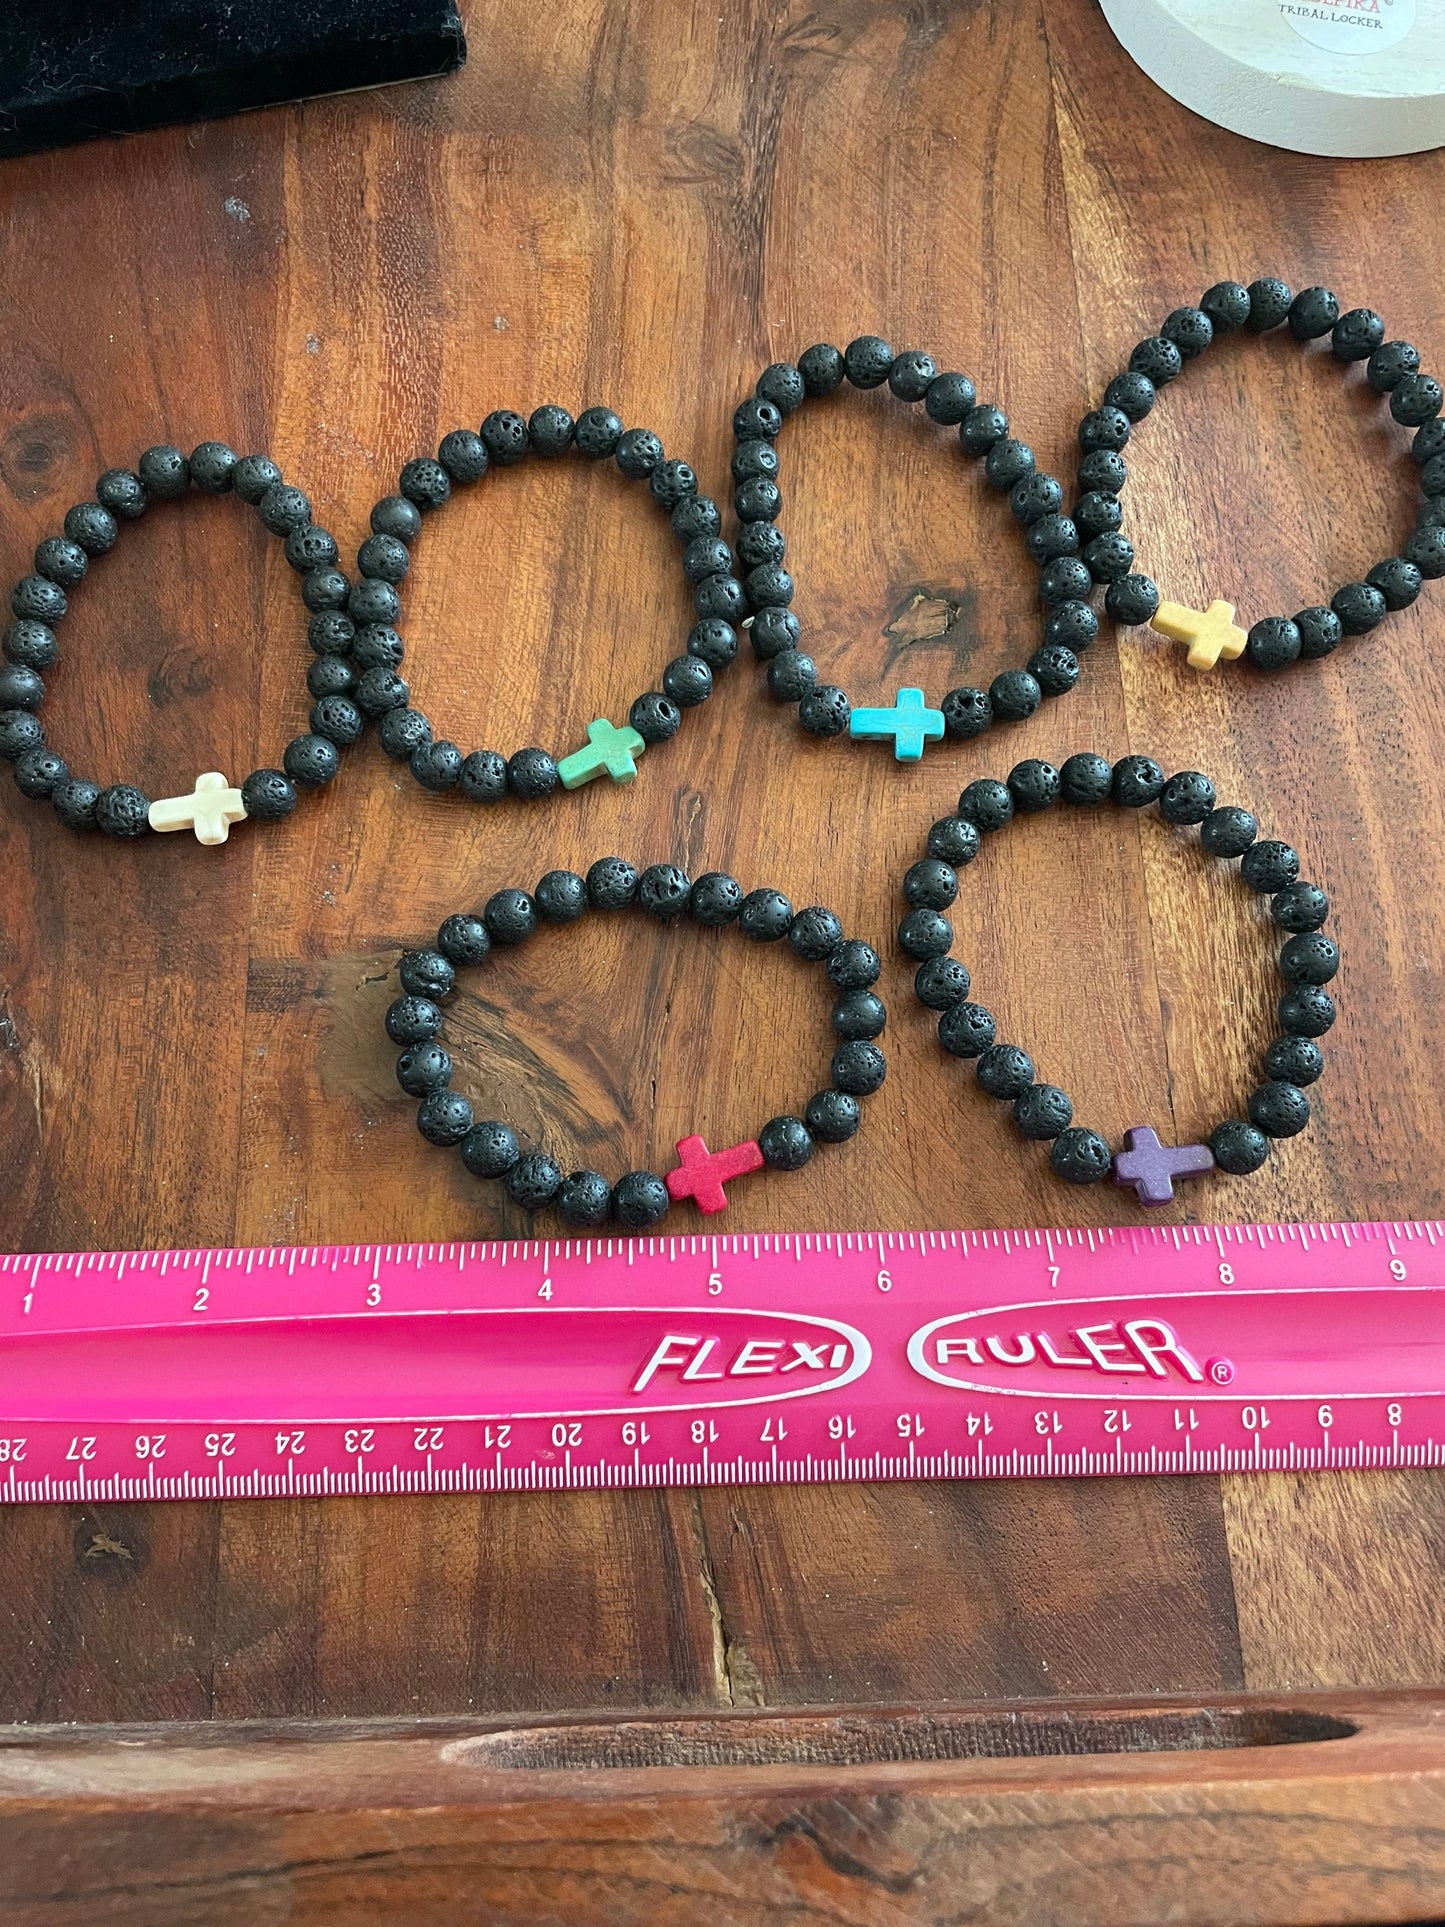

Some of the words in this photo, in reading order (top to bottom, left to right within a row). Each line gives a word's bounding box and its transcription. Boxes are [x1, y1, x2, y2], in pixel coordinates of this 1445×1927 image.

[1278, 4, 1328, 21] TRIBAL
[1331, 13, 1383, 29] LOCKER
[23, 1292, 33, 1314] 1
[193, 1287, 210, 1311] 2
[366, 1283, 382, 1306] 3
[537, 1278, 553, 1301] 4
[708, 1273, 723, 1296] 5
[877, 1269, 892, 1292] 6
[1047, 1266, 1061, 1288] 7
[1218, 1263, 1235, 1285] 8
[1389, 1258, 1407, 1281] 9
[632, 1334, 848, 1393] FLEXI
[936, 1319, 1205, 1382] RULER
[896, 1413, 925, 1437] 15
[966, 1412, 994, 1436] 14
[1034, 1411, 1063, 1435] 13
[1103, 1409, 1132, 1433] 12
[1174, 1408, 1200, 1431] 11
[1241, 1406, 1271, 1430] 10
[1317, 1404, 1333, 1428] 9
[1386, 1402, 1402, 1426] 8
[413, 1427, 444, 1451] 22
[484, 1425, 511, 1449] 21
[551, 1423, 582, 1447] 20
[622, 1421, 650, 1445] 19
[691, 1419, 719, 1444] 18
[760, 1417, 788, 1442] 17
[828, 1415, 856, 1439] 16
[0, 1438, 27, 1462] 28
[65, 1436, 97, 1460] 27
[135, 1435, 166, 1459] 26
[204, 1433, 236, 1457] 25
[274, 1431, 305, 1455] 24
[344, 1429, 375, 1453] 23
